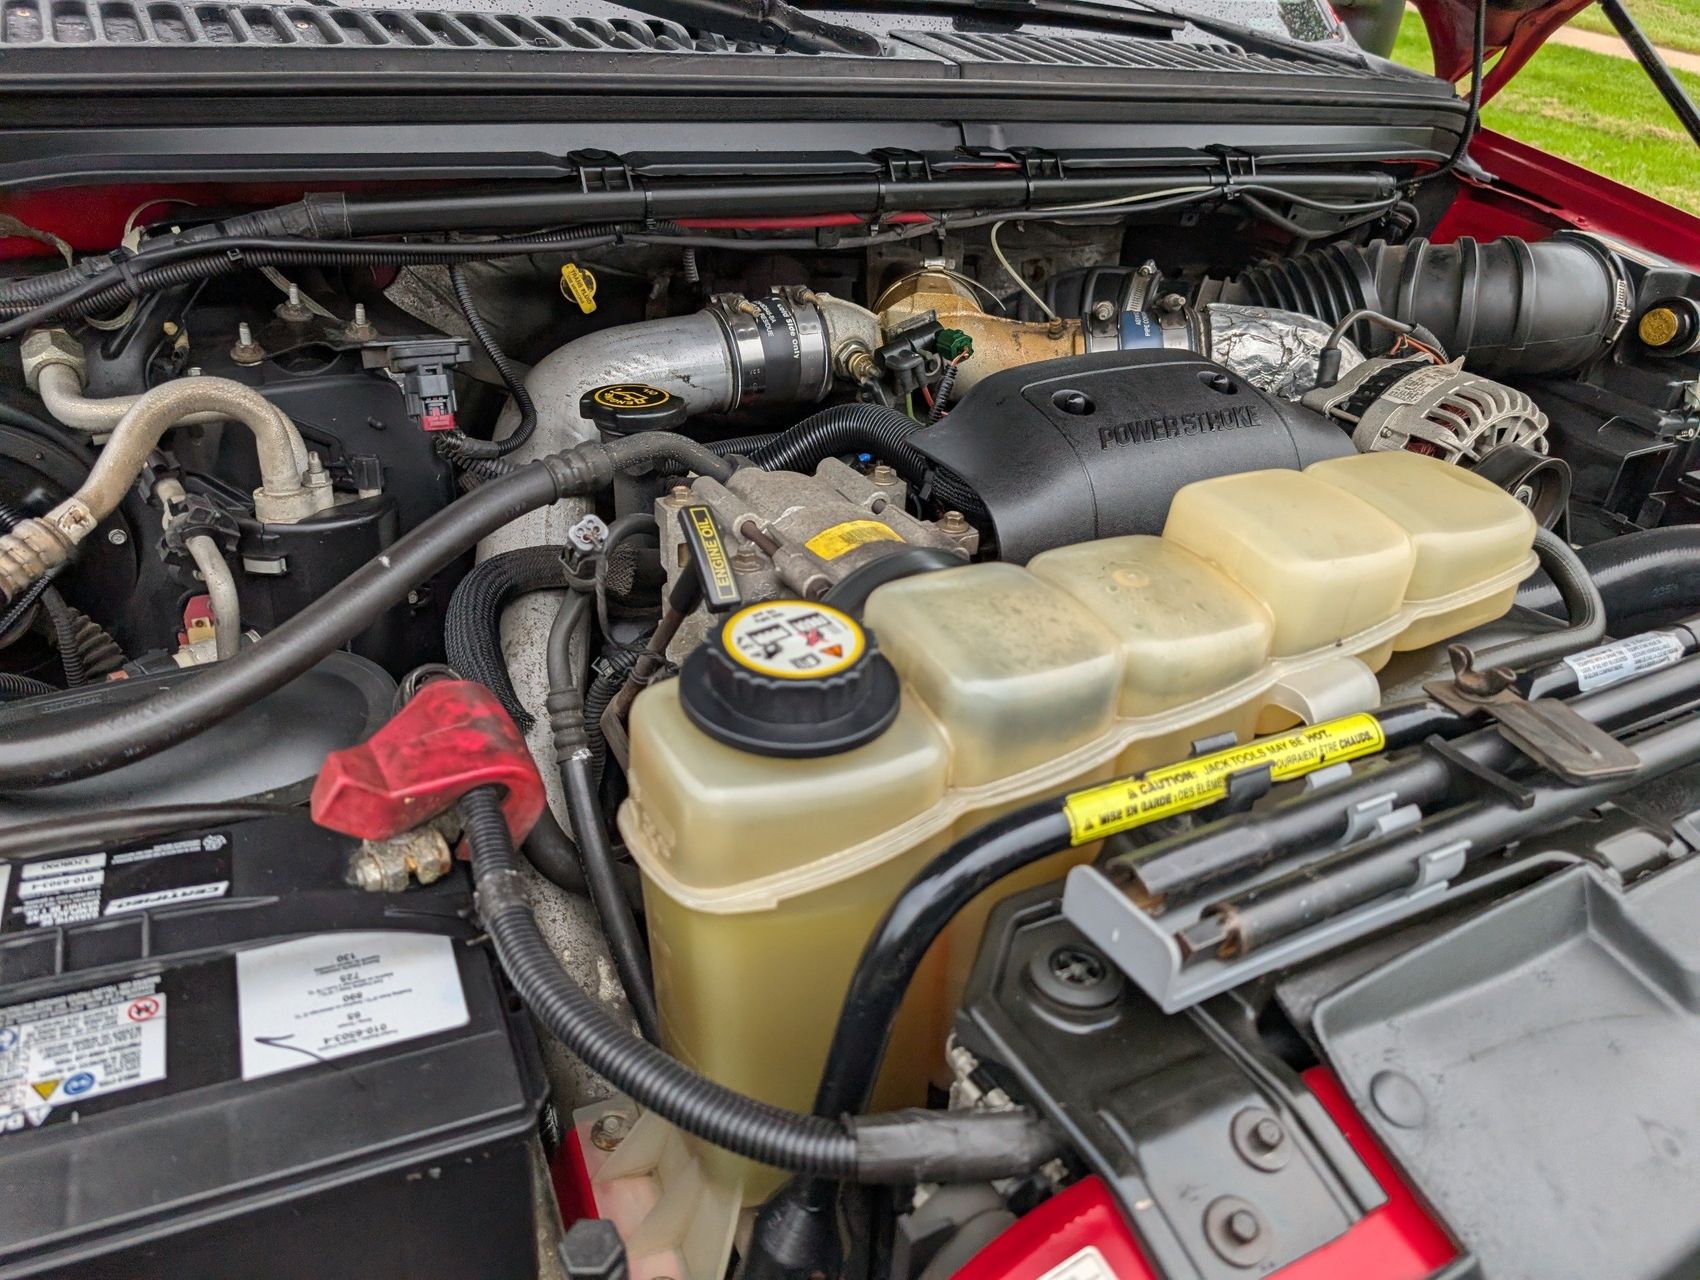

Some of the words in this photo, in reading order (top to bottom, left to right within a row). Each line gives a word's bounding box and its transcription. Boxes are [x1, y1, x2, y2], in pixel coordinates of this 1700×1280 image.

[785, 318, 797, 336] Side
[697, 517, 713, 539] OIL
[704, 540, 729, 588] ENGINE
[1139, 769, 1198, 795] CAUTION:
[1202, 755, 1231, 775] JACK
[1229, 747, 1267, 769] TOOLS
[1268, 740, 1289, 756] MAY
[1289, 736, 1304, 748] BE
[1307, 729, 1333, 746] HOT.
[1100, 810, 1124, 825] MISE
[1125, 804, 1140, 818] EN
[118, 885, 220, 909] CERTIFIED
[336, 951, 356, 962] 130
[339, 971, 360, 983] 725
